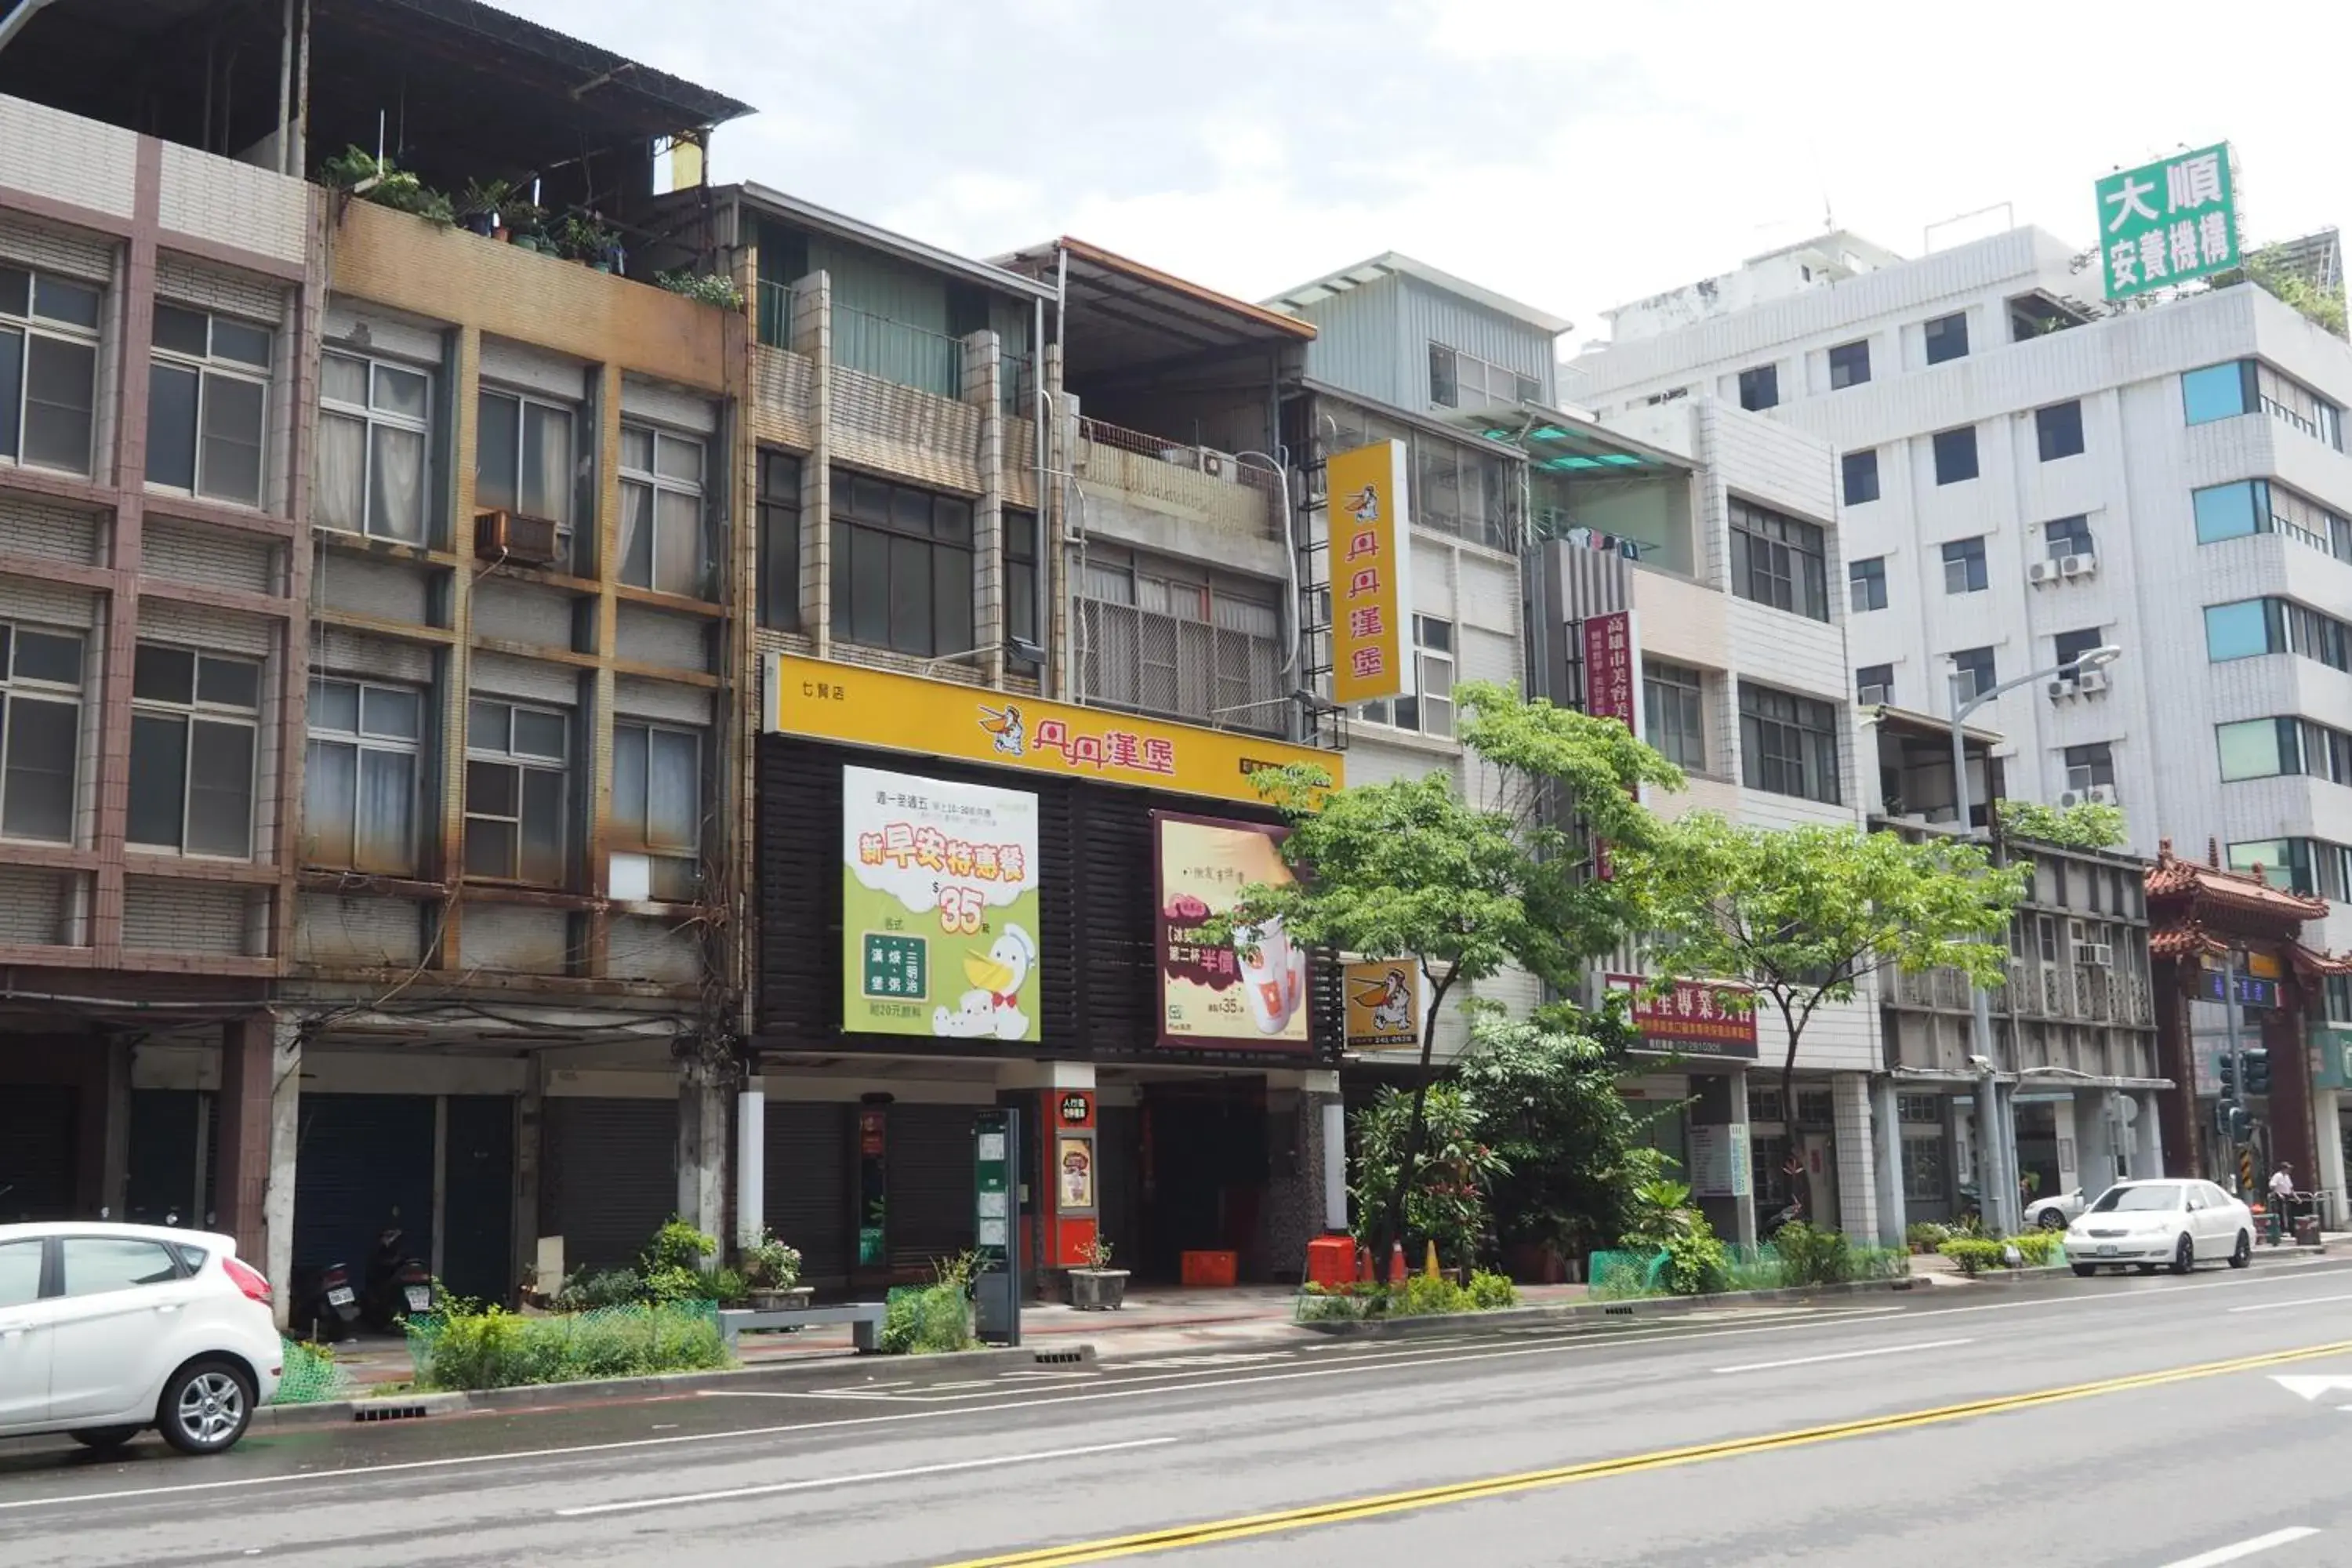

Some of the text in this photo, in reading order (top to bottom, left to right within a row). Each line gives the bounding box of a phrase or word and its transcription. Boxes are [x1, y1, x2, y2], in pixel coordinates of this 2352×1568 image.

[2106, 153, 2223, 233] 大順
[2109, 211, 2230, 291] 安養機構
[1345, 529, 1385, 679] 丹丹漢堡
[803, 681, 844, 701] 七賢店
[1607, 617, 1630, 726] 高雄市美容美
[1033, 720, 1174, 775] 丹丹漢堡
[859, 822, 1025, 883] 新早安特惠餐
[906, 951, 918, 993] 三明治
